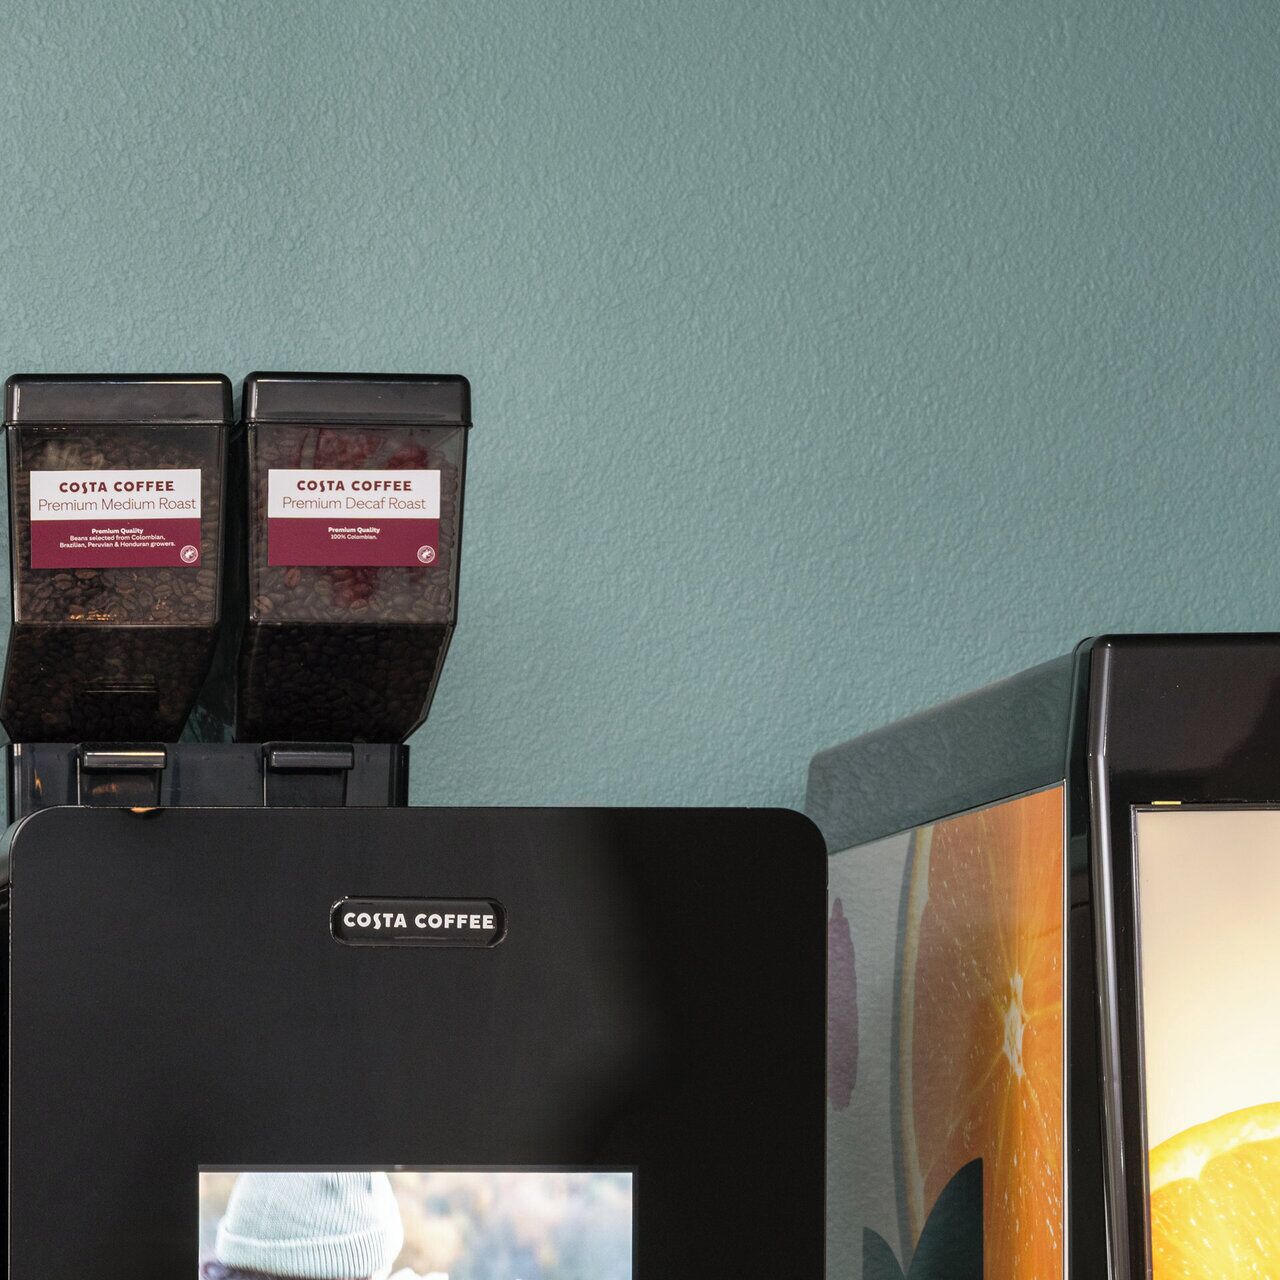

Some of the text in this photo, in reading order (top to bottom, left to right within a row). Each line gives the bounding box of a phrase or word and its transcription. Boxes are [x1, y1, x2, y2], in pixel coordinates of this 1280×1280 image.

[59, 480, 175, 494] COSTA COFFEE
[297, 480, 413, 492] COSTA COFFEE
[38, 497, 197, 511] Premium Medium Roast
[282, 497, 426, 509] Premium Decaf Roast
[343, 912, 496, 930] COSTA COFFEE
